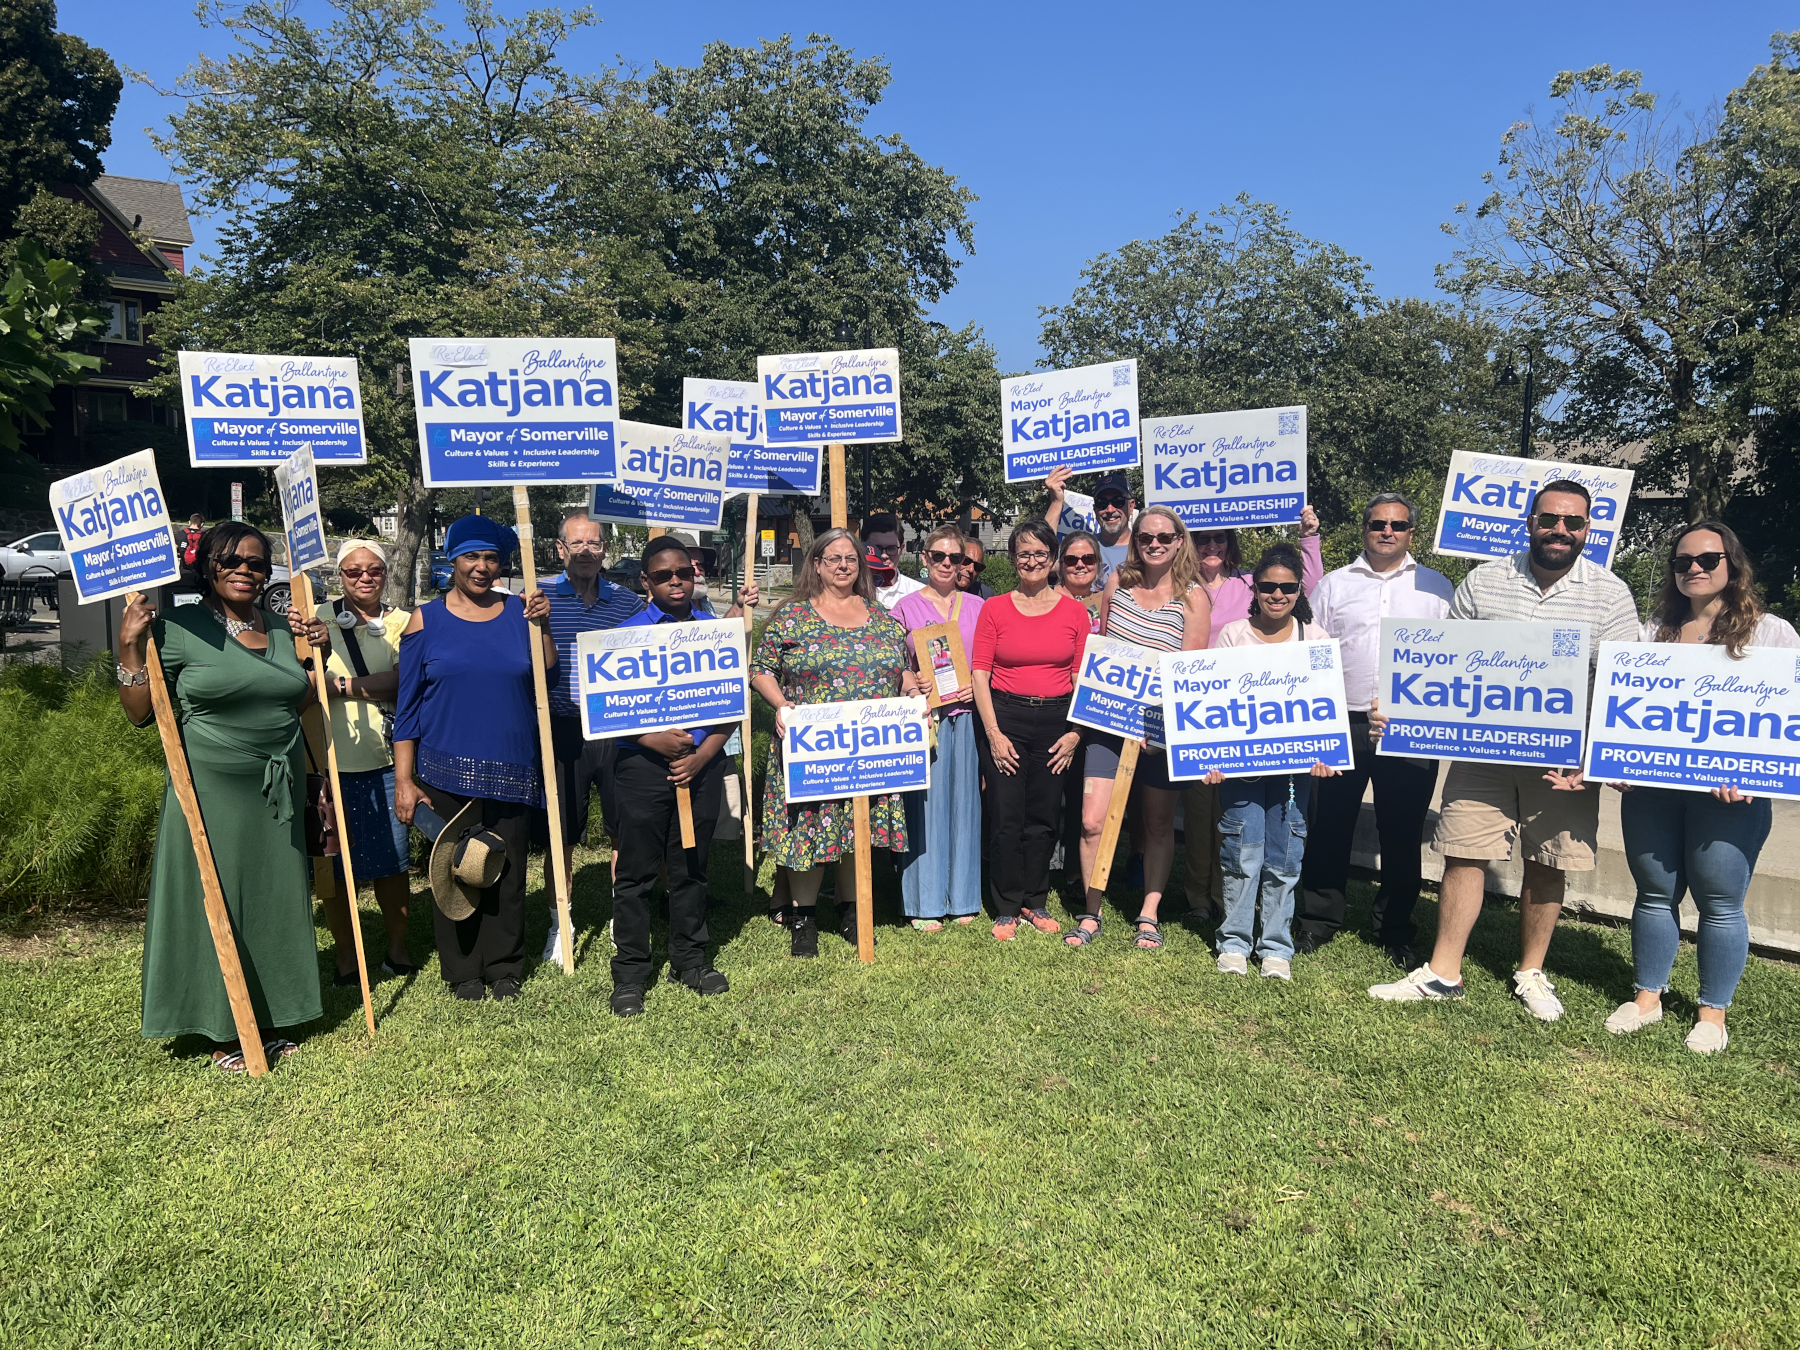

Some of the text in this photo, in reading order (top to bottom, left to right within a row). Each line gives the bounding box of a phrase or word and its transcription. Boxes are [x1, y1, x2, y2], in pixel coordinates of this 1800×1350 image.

[204, 357, 255, 372] Re-Elect
[434, 346, 486, 362] Re-Elect
[281, 361, 348, 388] Ballantyne
[523, 350, 606, 382] Ballantyne
[831, 355, 888, 377] Ballantyne
[191, 375, 355, 417] Katjana
[420, 369, 612, 417] Katjana
[765, 370, 892, 404] Katjana
[1011, 383, 1043, 396] Re-Elect
[1011, 389, 1112, 412] Mayor Ballantyne
[780, 406, 893, 423] Mayor of Somerville
[214, 422, 357, 438] Mayor of Somerville
[451, 428, 608, 444] Mayor of Somerville
[1011, 408, 1130, 443] Katjana
[1154, 424, 1194, 438] Re-Elect
[673, 434, 723, 462] Ballantyne
[743, 449, 752, 461] of
[753, 449, 814, 462] Somerville
[1013, 442, 1132, 467] PROVEN LEADERSHIP
[1154, 436, 1276, 459] Mayor Ballantyne
[518, 460, 560, 468] Experience
[1092, 457, 1115, 465] Results
[1473, 458, 1524, 476] Re-Elect
[103, 465, 148, 496] Ballantyne
[750, 473, 778, 481] Experience
[1154, 458, 1296, 494] Katjana
[613, 483, 719, 504] Mayor of Somerville
[58, 487, 163, 541] Katjana
[608, 498, 710, 514] Culture Values Inclusive Leadership
[638, 509, 685, 520] Skills Experience
[1214, 498, 1298, 513] LEADERSHIP
[1462, 517, 1510, 534] Mayor
[1511, 524, 1523, 537] of
[1456, 532, 1511, 545] Culture Values
[83, 532, 170, 567] Mayor of Somerville
[1490, 546, 1508, 554] Skills
[86, 554, 166, 580] Culture Values Inclusive Leadership
[109, 572, 146, 586] Skills Experience
[604, 631, 651, 647] Re-Elect
[669, 627, 734, 650] Ballantyne
[1394, 628, 1445, 644] Re-Elect
[586, 645, 739, 685] Katjana
[1172, 659, 1216, 674] Re-Elect
[1393, 648, 1548, 681] Mayor Ballantyne
[1614, 652, 1671, 667] Re-Elect
[1085, 653, 1162, 699] Katja
[1174, 671, 1309, 695] Mayor Ballantyne
[606, 682, 741, 707] Mayor of Somerville
[1391, 672, 1573, 718] Katjana
[1611, 671, 1790, 707] Mayor Ballantyne
[669, 702, 696, 712] Inclusive
[697, 699, 731, 707] Leadership
[1090, 692, 1126, 710] Mayor
[1127, 704, 1137, 715] of
[665, 713, 699, 722] Experience
[801, 708, 840, 721] Re-Elect
[860, 704, 917, 726] Ballantyne
[1086, 705, 1104, 714] Culture
[1110, 712, 1127, 721] Values
[1136, 718, 1160, 730] Inclusive
[1175, 695, 1336, 735] Katjana
[789, 720, 922, 756] Katjana
[1110, 721, 1124, 729] Skills
[1130, 727, 1159, 738] Experience
[1390, 723, 1572, 748] PROVEN LEADERSHIP
[1179, 739, 1340, 761] PROVEN LEADERSHIP
[1410, 741, 1545, 758] Experience Values Results
[805, 755, 923, 775] Mayor of Somerville
[1199, 762, 1244, 770] Experience
[1288, 756, 1319, 764] Results
[1601, 748, 1800, 776] PROVEN LEADERSHI
[884, 769, 914, 777] Leadership
[1623, 767, 1783, 788] Experience Values Results
[855, 781, 885, 789] Experience
